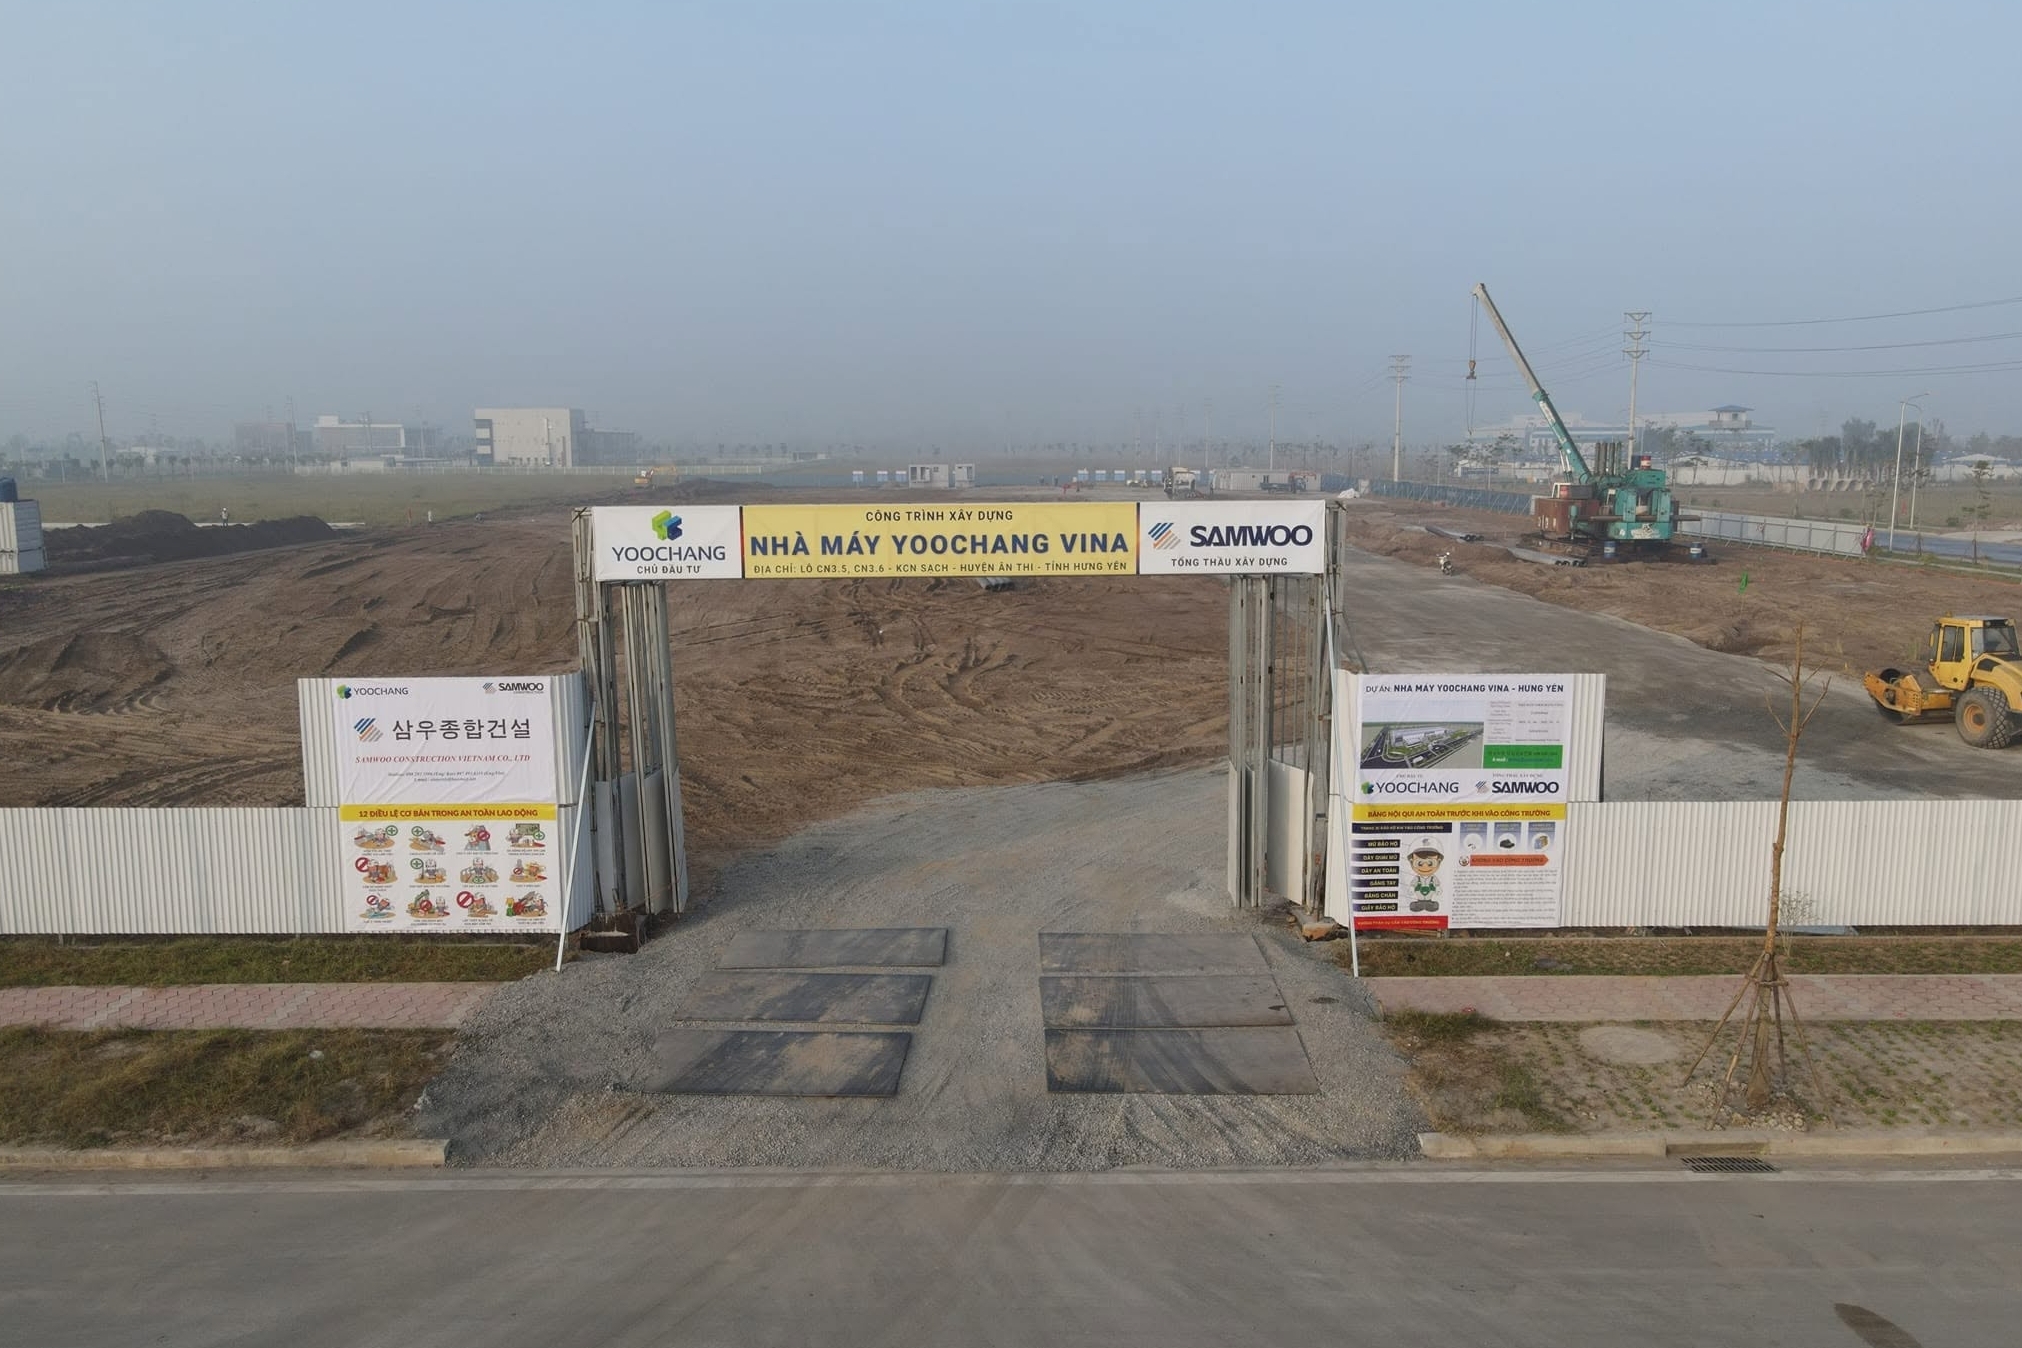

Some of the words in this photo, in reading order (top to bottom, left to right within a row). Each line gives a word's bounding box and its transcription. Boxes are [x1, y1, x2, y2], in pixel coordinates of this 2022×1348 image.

[866, 509, 901, 522] CÔNG
[906, 509, 944, 521] TRÌNH
[949, 508, 973, 521] XÂY
[978, 510, 1013, 523] DỰNG
[1190, 524, 1313, 547] SAMWOO
[750, 530, 810, 556] NHÀ
[821, 530, 880, 555] MÁY
[892, 533, 1049, 555] YOOCHANG
[1060, 532, 1129, 554] VINA
[612, 546, 726, 562] YOOCHANG
[1171, 556, 1200, 567] TỔNG
[1204, 556, 1231, 567] THẦU
[1235, 556, 1255, 566] XÂY
[1259, 557, 1288, 568] DỰNG
[637, 563, 658, 574] CHỦ
[661, 563, 683, 574] ĐẦU
[686, 563, 702, 574] TƯ
[754, 565, 771, 576] ĐỊA
[801, 563, 813, 573] LÔ
[854, 564, 885, 573] CN3.6
[896, 563, 917, 573] KCN
[960, 561, 995, 574] HUYỆN
[1017, 563, 1034, 572] THI
[1045, 560, 1070, 571] TỈNH
[1074, 561, 1103, 571] HƯNG
[1107, 561, 1127, 571] YÊN
[353, 687, 409, 696] YOOCHANG
[498, 682, 544, 691] SAMWOO
[1437, 684, 1486, 693] YOOCHANG
[1488, 684, 1510, 692] VINA
[392, 718, 532, 741] 삼우종합건설
[355, 756, 392, 764] SAMWOO
[514, 754, 531, 762] LTD
[1376, 782, 1460, 793] YOOCHANG
[1492, 781, 1559, 793] SAMWOO
[431, 809, 459, 817] TRONG
[473, 808, 495, 816] TOÀN
[514, 808, 538, 817] ĐỘNG
[1402, 810, 1414, 818] QUI
